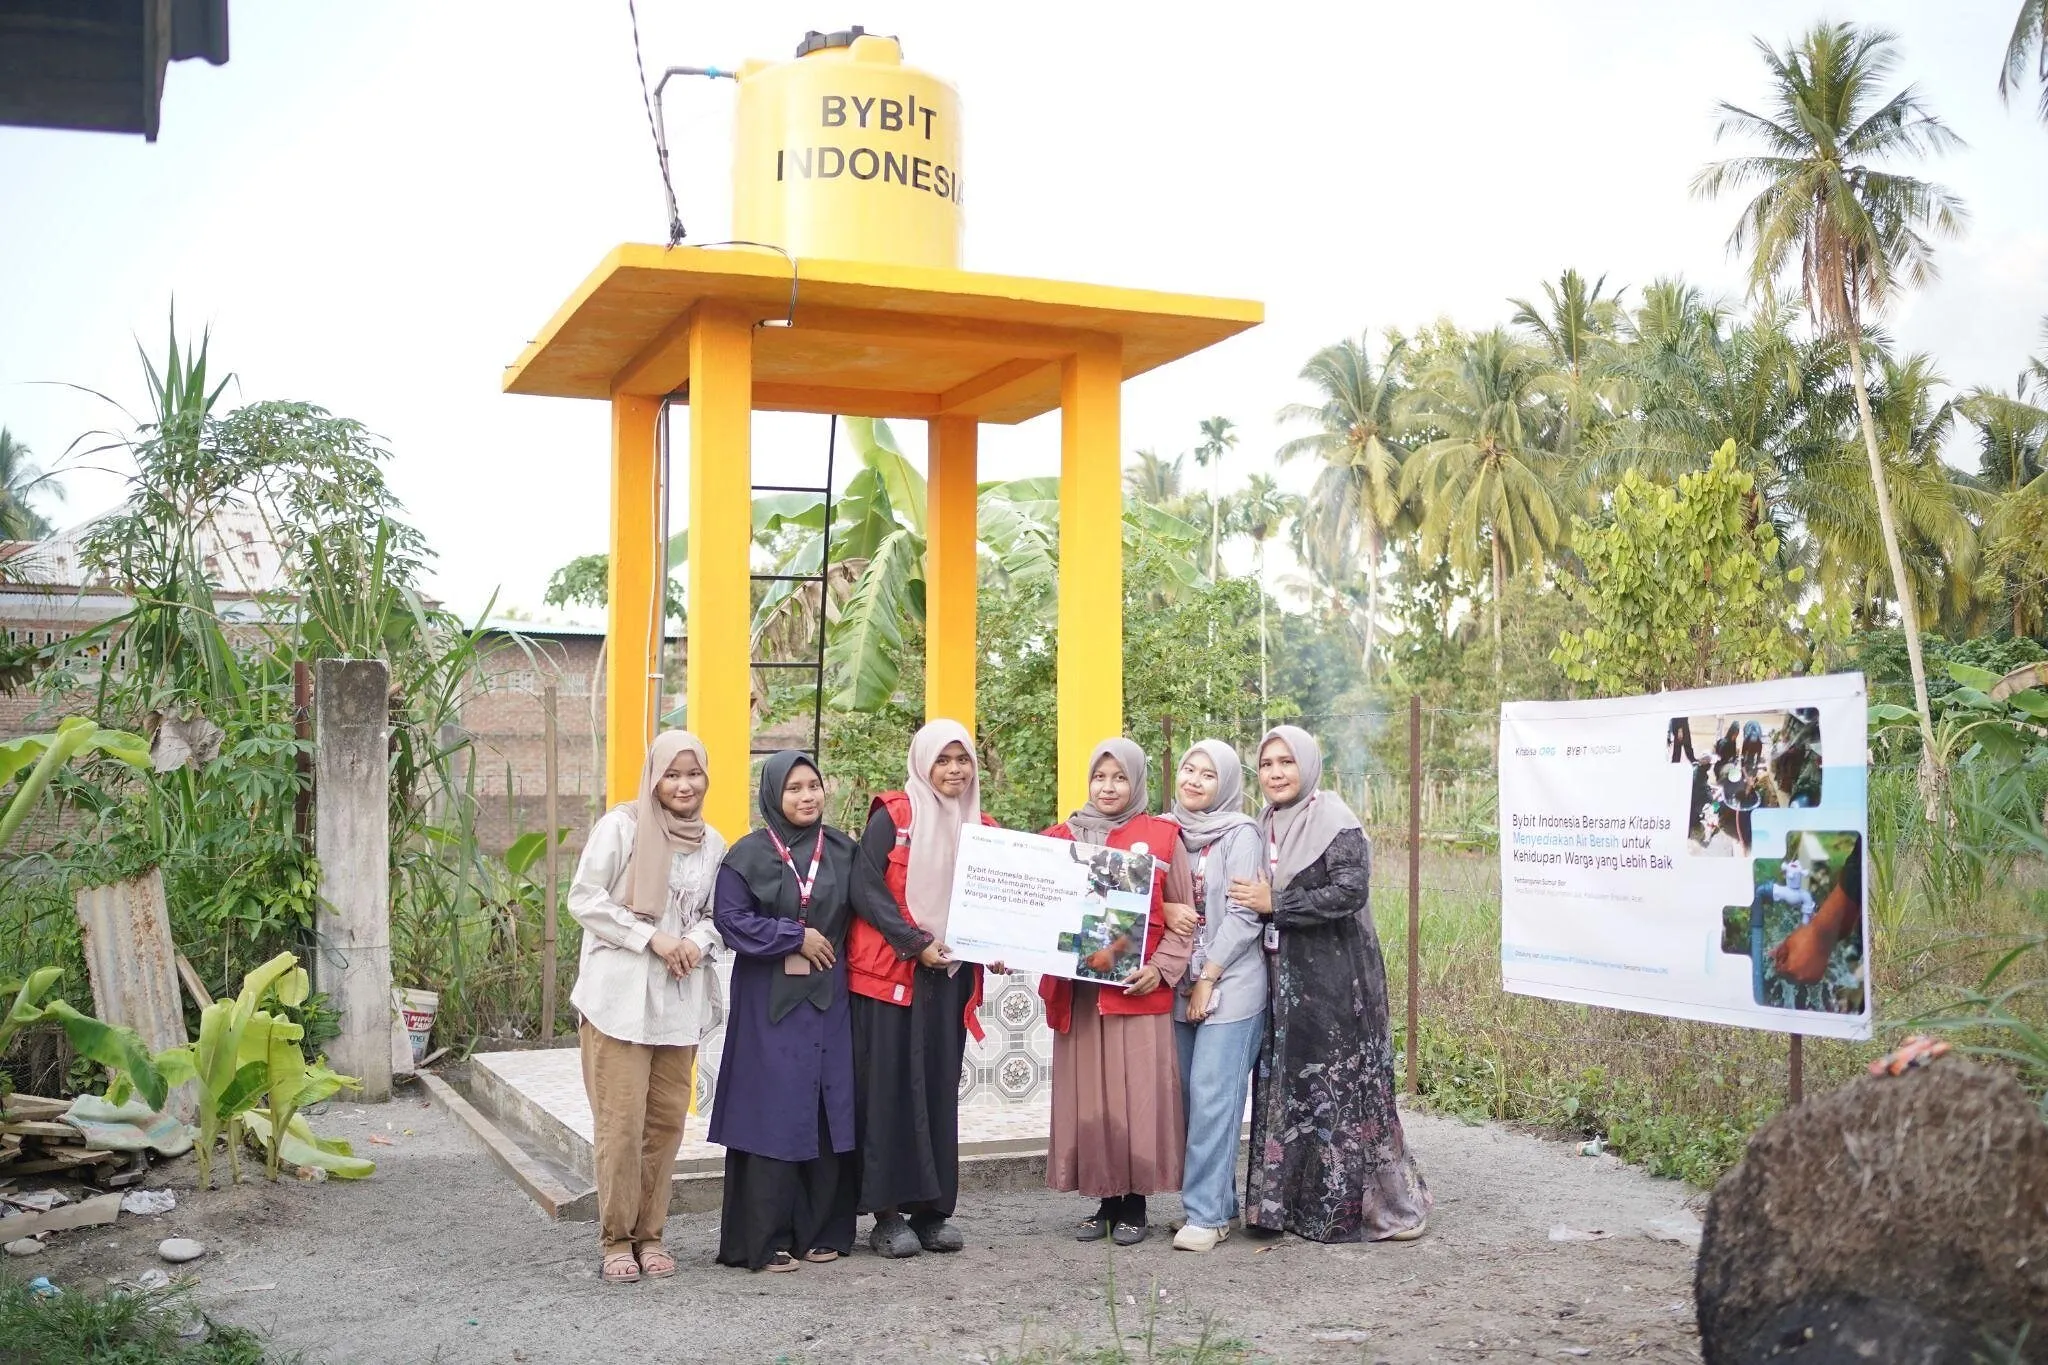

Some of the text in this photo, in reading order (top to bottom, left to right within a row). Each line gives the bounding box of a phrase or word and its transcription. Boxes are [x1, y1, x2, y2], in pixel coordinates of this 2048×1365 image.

[822, 95, 937, 140] BYBIT
[1512, 814, 1671, 830] Bybit Indonesia Bersama Kitabisa
[1513, 832, 1652, 849] Menyediakan Air Bersih untuk
[1513, 850, 1673, 870] Kehidupan Warga yang Lebih Baik
[967, 873, 996, 884] Kitabisa
[998, 878, 1036, 890] Membantu
[968, 864, 1055, 885] Bybit Indonesia Bersama
[964, 888, 1046, 907] Warga yang Lebih Baik
[1001, 887, 1022, 896] untuk
[1023, 890, 1062, 903] Kehidupan
